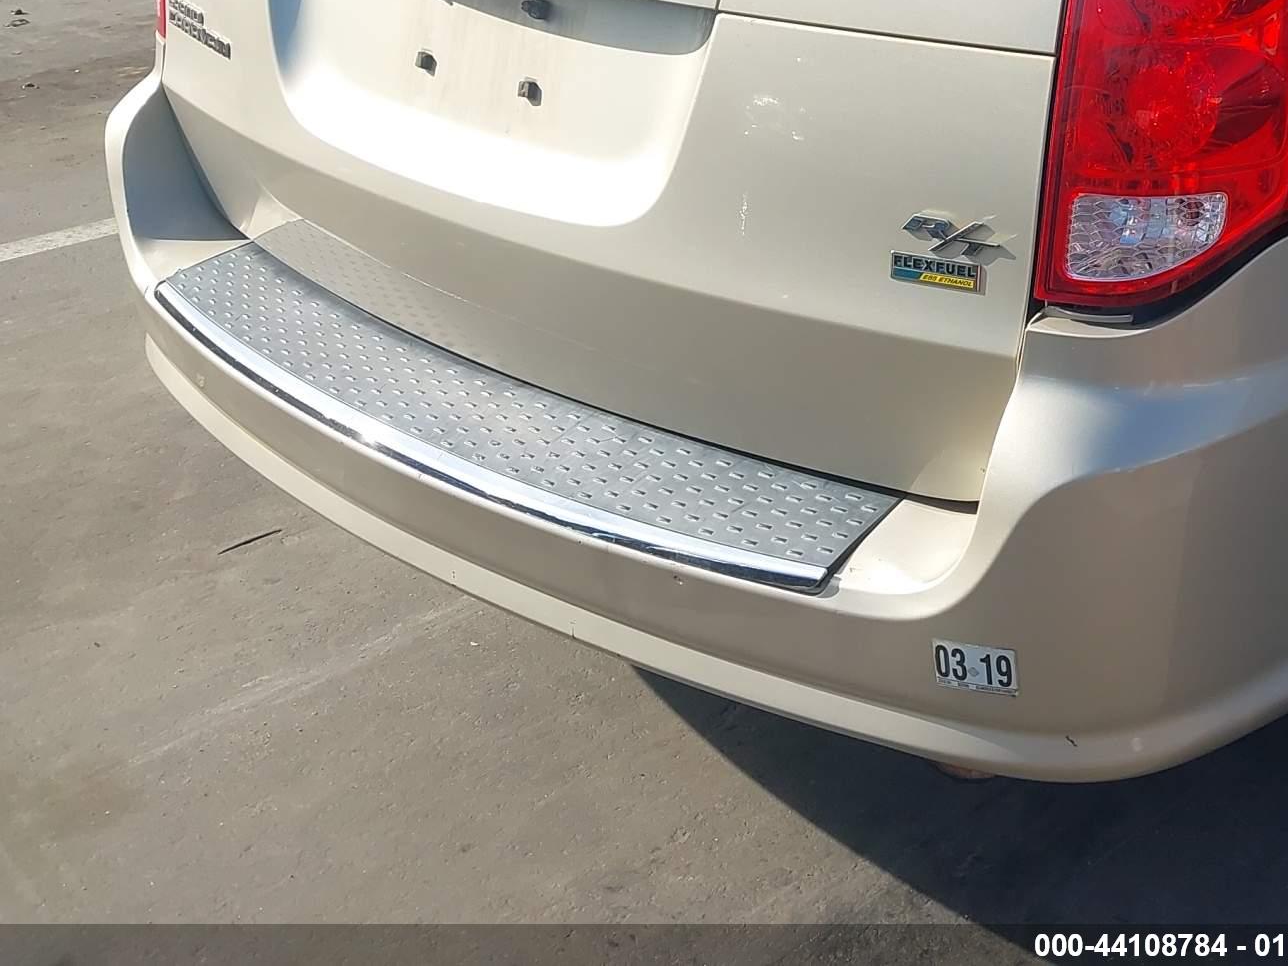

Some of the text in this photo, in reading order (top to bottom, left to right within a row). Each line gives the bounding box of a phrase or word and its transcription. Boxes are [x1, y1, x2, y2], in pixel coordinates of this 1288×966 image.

[893, 254, 976, 278] FLEXFUEL
[934, 644, 968, 681] 03
[979, 653, 1013, 688] 19
